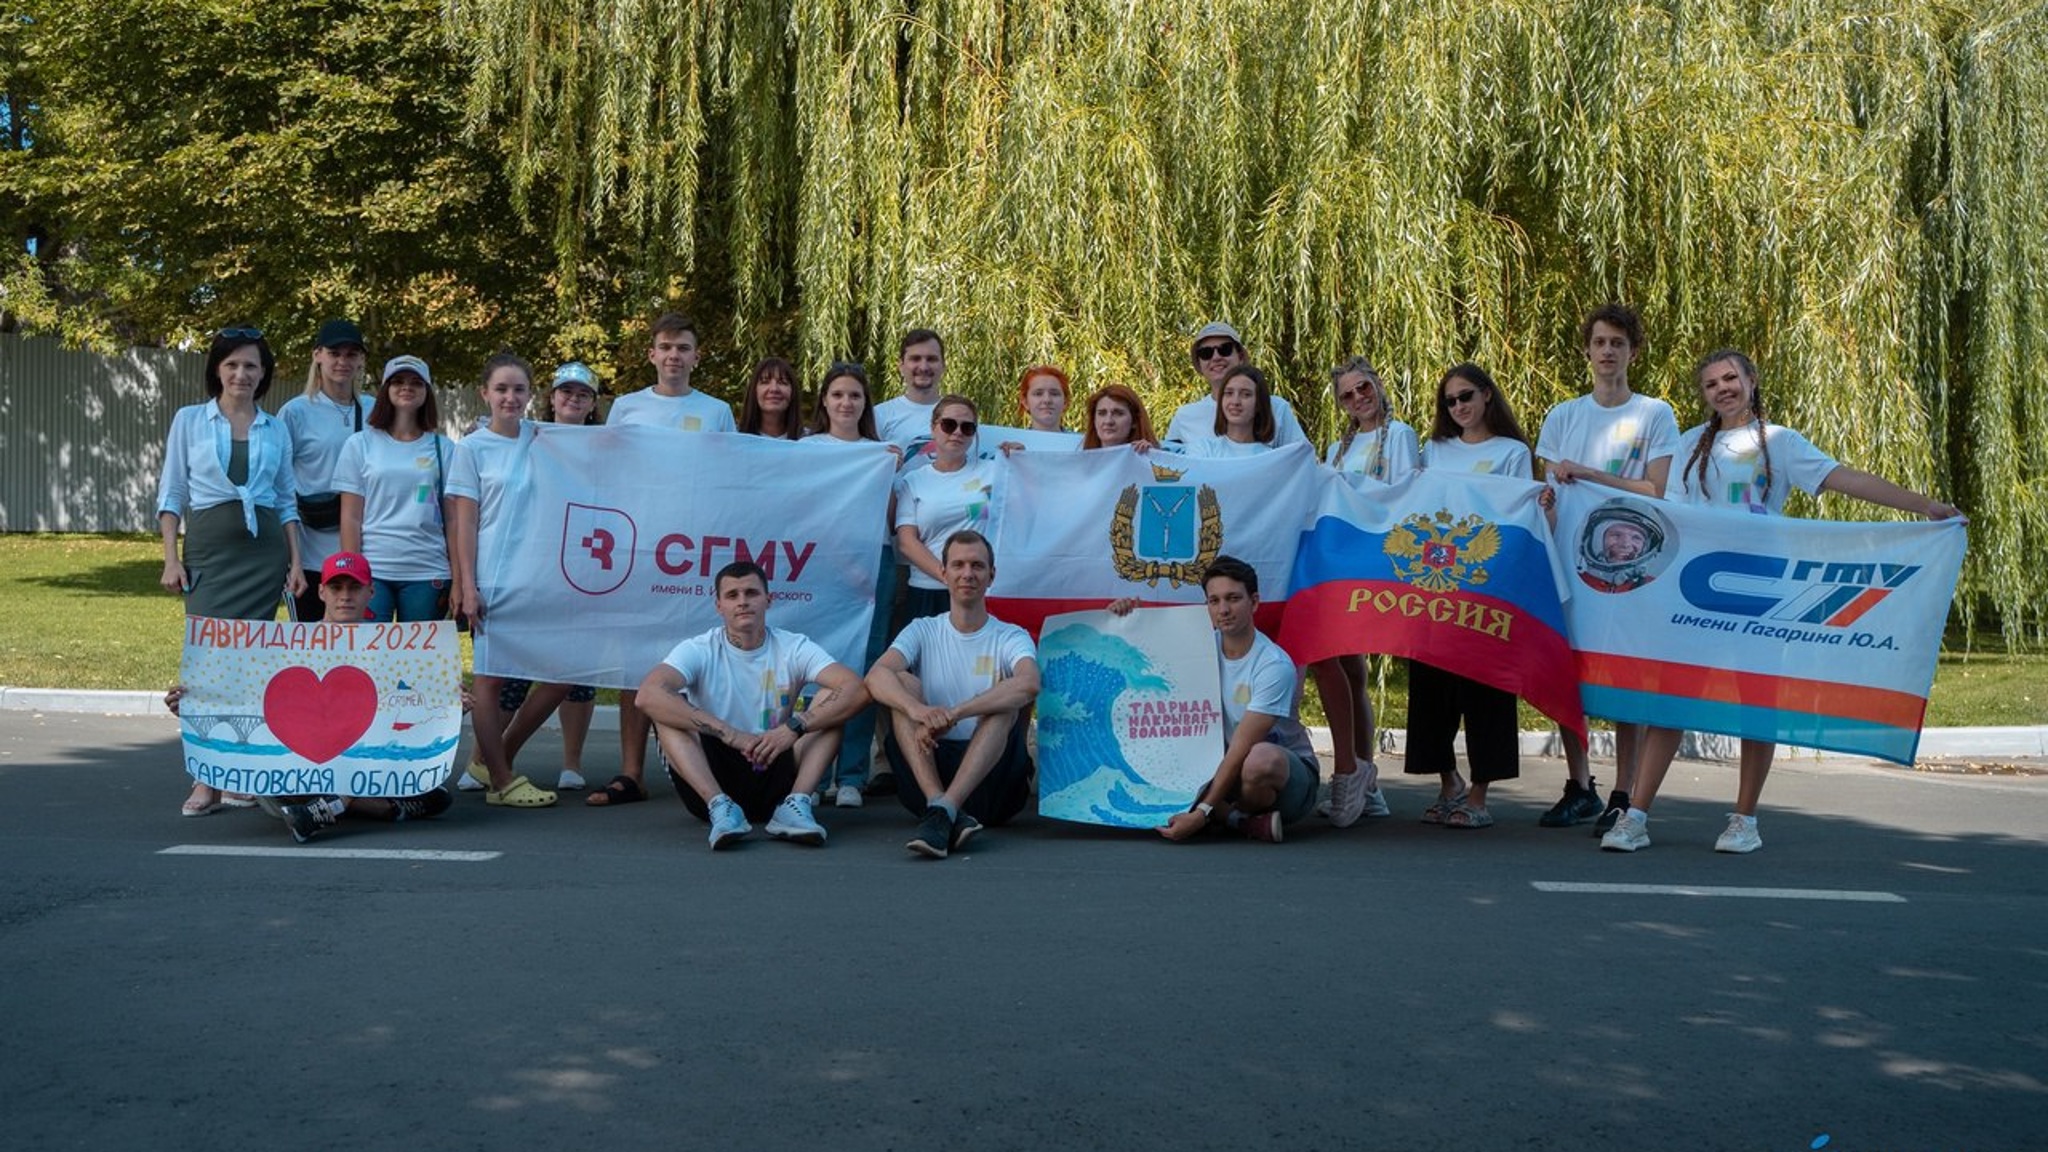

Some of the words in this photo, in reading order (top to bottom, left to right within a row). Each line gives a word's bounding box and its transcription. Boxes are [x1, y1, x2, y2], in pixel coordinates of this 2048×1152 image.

[655, 533, 817, 582] СГМУ
[650, 584, 692, 595] имени
[694, 585, 706, 597] В.
[1347, 588, 1515, 642] РОССИЯ
[1671, 612, 1737, 632] имени
[1742, 620, 1842, 645] Гагарина
[1848, 632, 1900, 651] Ю.А.
[1128, 699, 1211, 713] ТАВРИДА
[1129, 712, 1219, 726] НАКРЫВАЕТ
[187, 756, 335, 793] САРАТОВСКАЯ
[350, 758, 451, 796] ОБЛАСТЬ
